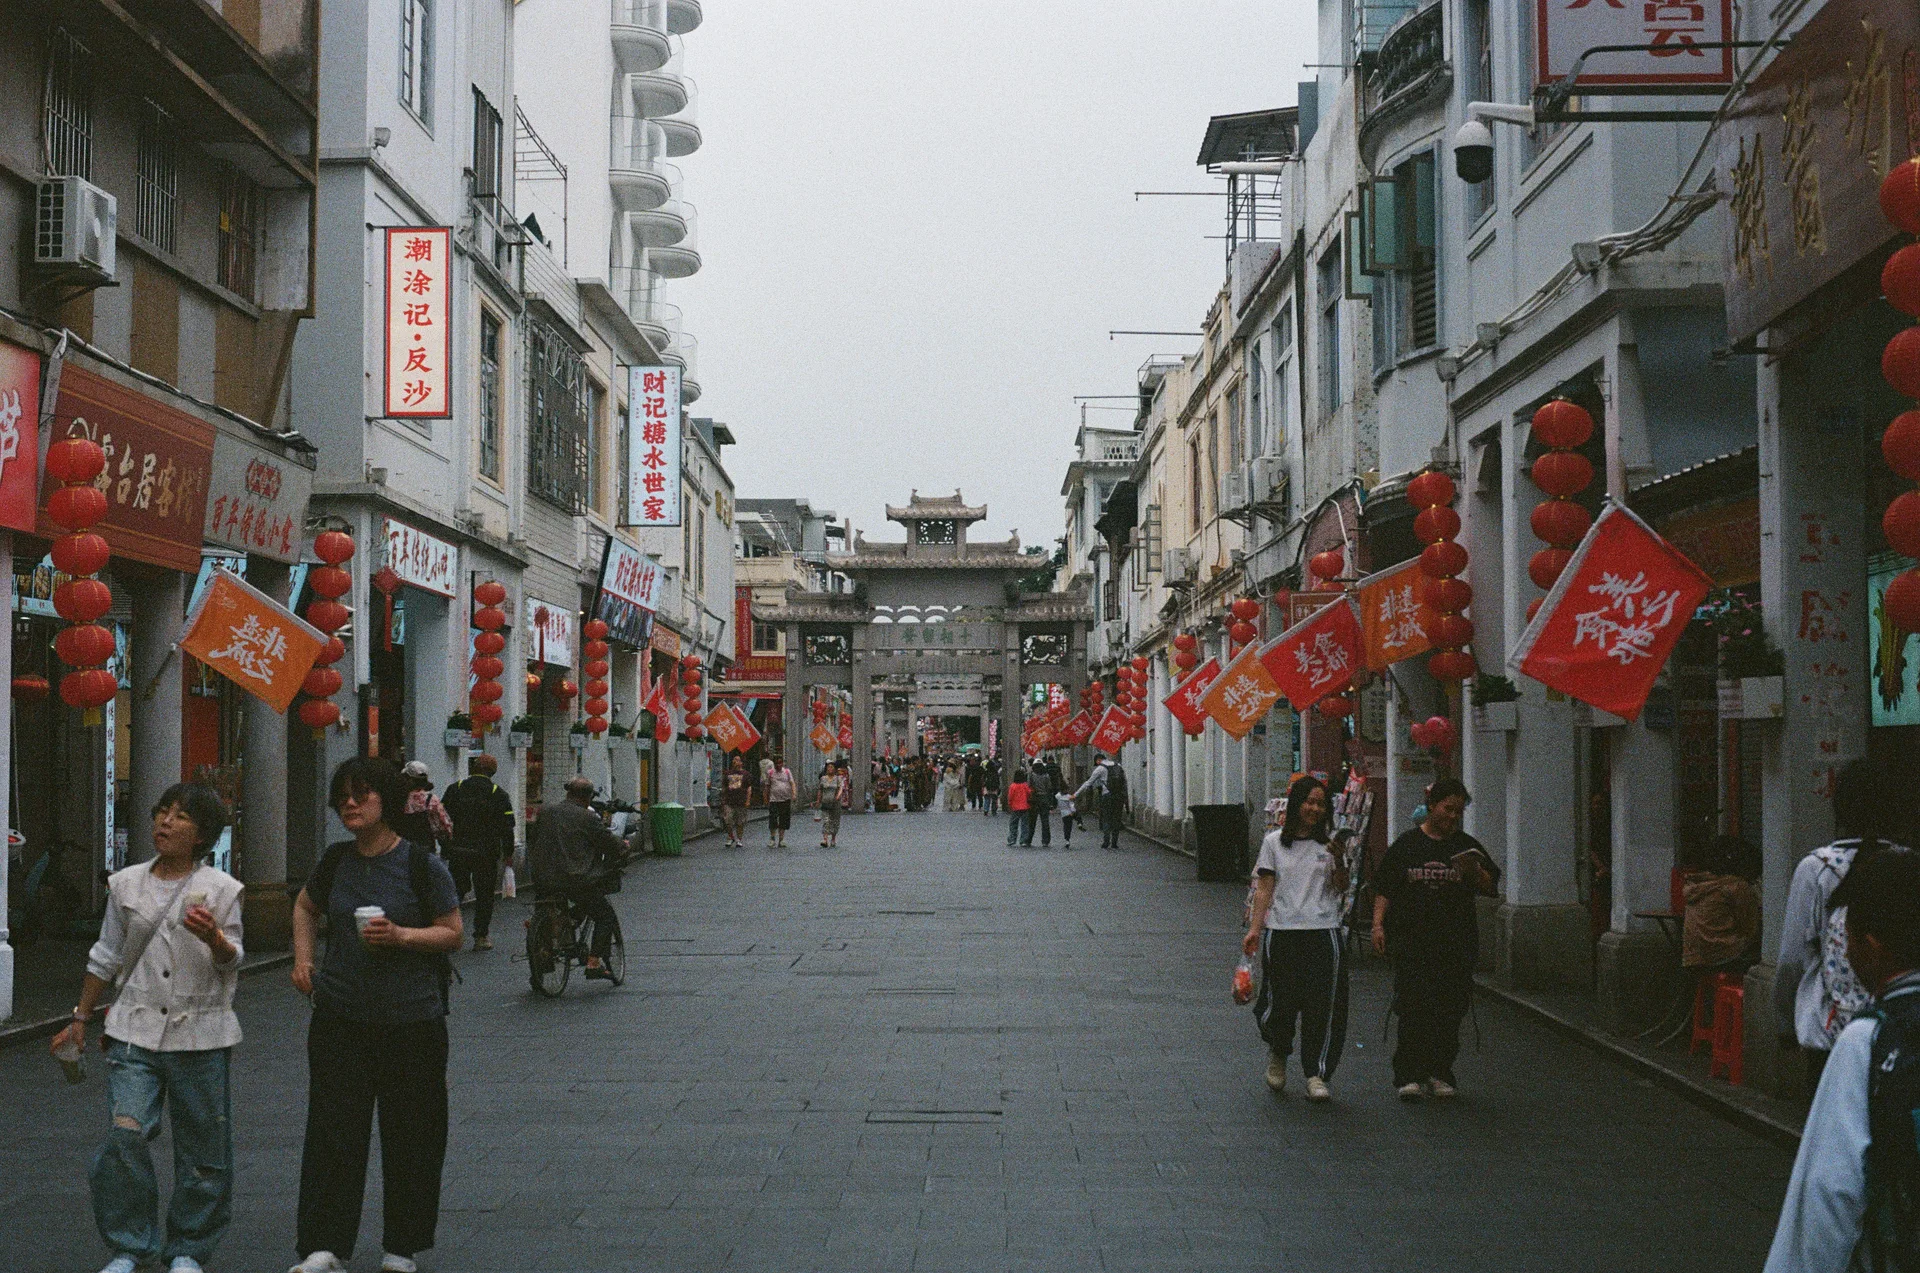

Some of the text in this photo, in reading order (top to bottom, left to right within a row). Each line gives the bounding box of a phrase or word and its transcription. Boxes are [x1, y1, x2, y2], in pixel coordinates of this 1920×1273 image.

[402, 237, 433, 407] 潮涂记·反沙
[641, 370, 669, 522] 财记糖水世家
